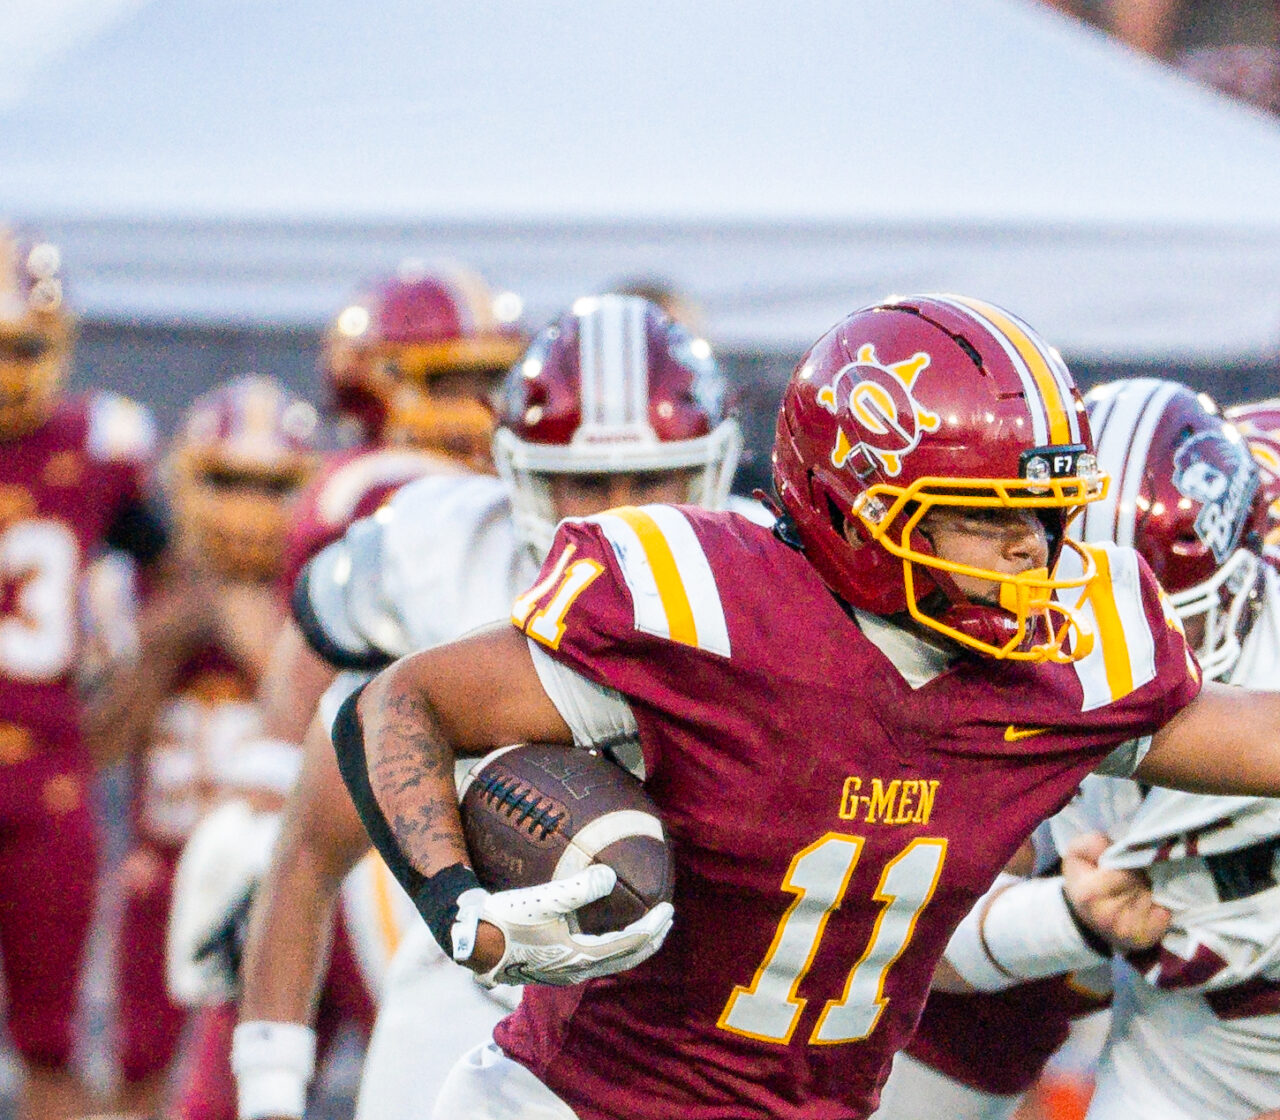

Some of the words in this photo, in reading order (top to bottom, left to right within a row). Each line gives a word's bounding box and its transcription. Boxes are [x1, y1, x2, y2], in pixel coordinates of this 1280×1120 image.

[1054, 456, 1073, 473] F7
[511, 543, 606, 651] 11
[838, 775, 941, 826] G-MEN
[715, 831, 949, 1046] 11
